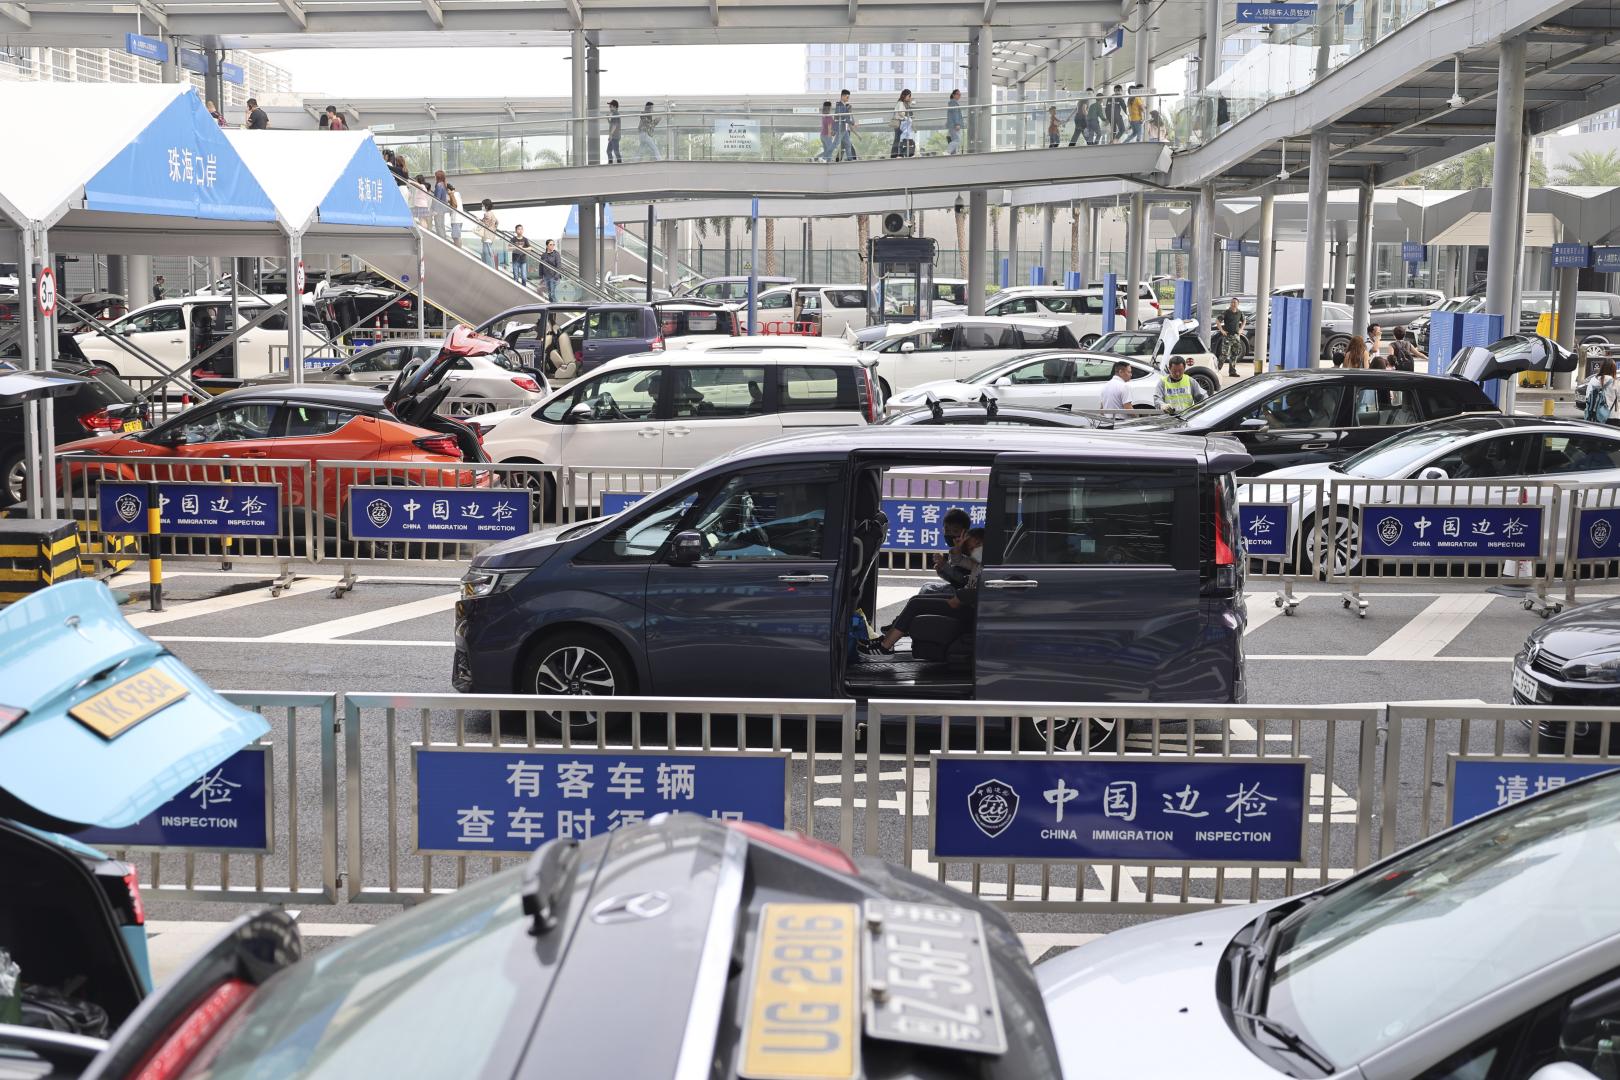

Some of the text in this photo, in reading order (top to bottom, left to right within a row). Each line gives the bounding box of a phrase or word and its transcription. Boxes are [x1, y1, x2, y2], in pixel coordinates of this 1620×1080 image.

[167, 148, 217, 187] 珠海口岸
[358, 177, 383, 203] 珠海口岸
[402, 498, 518, 522] 中国边检
[897, 503, 988, 525] 有客辆
[1413, 516, 1529, 539] 中国边检
[506, 760, 696, 800] 有客车辆
[1042, 778, 1279, 824] 中国边检
[161, 816, 238, 828] INSPECTION
[1040, 829, 1272, 843] CHINA IMMIGRATION INSPECTION
[769, 914, 844, 986] 2816
